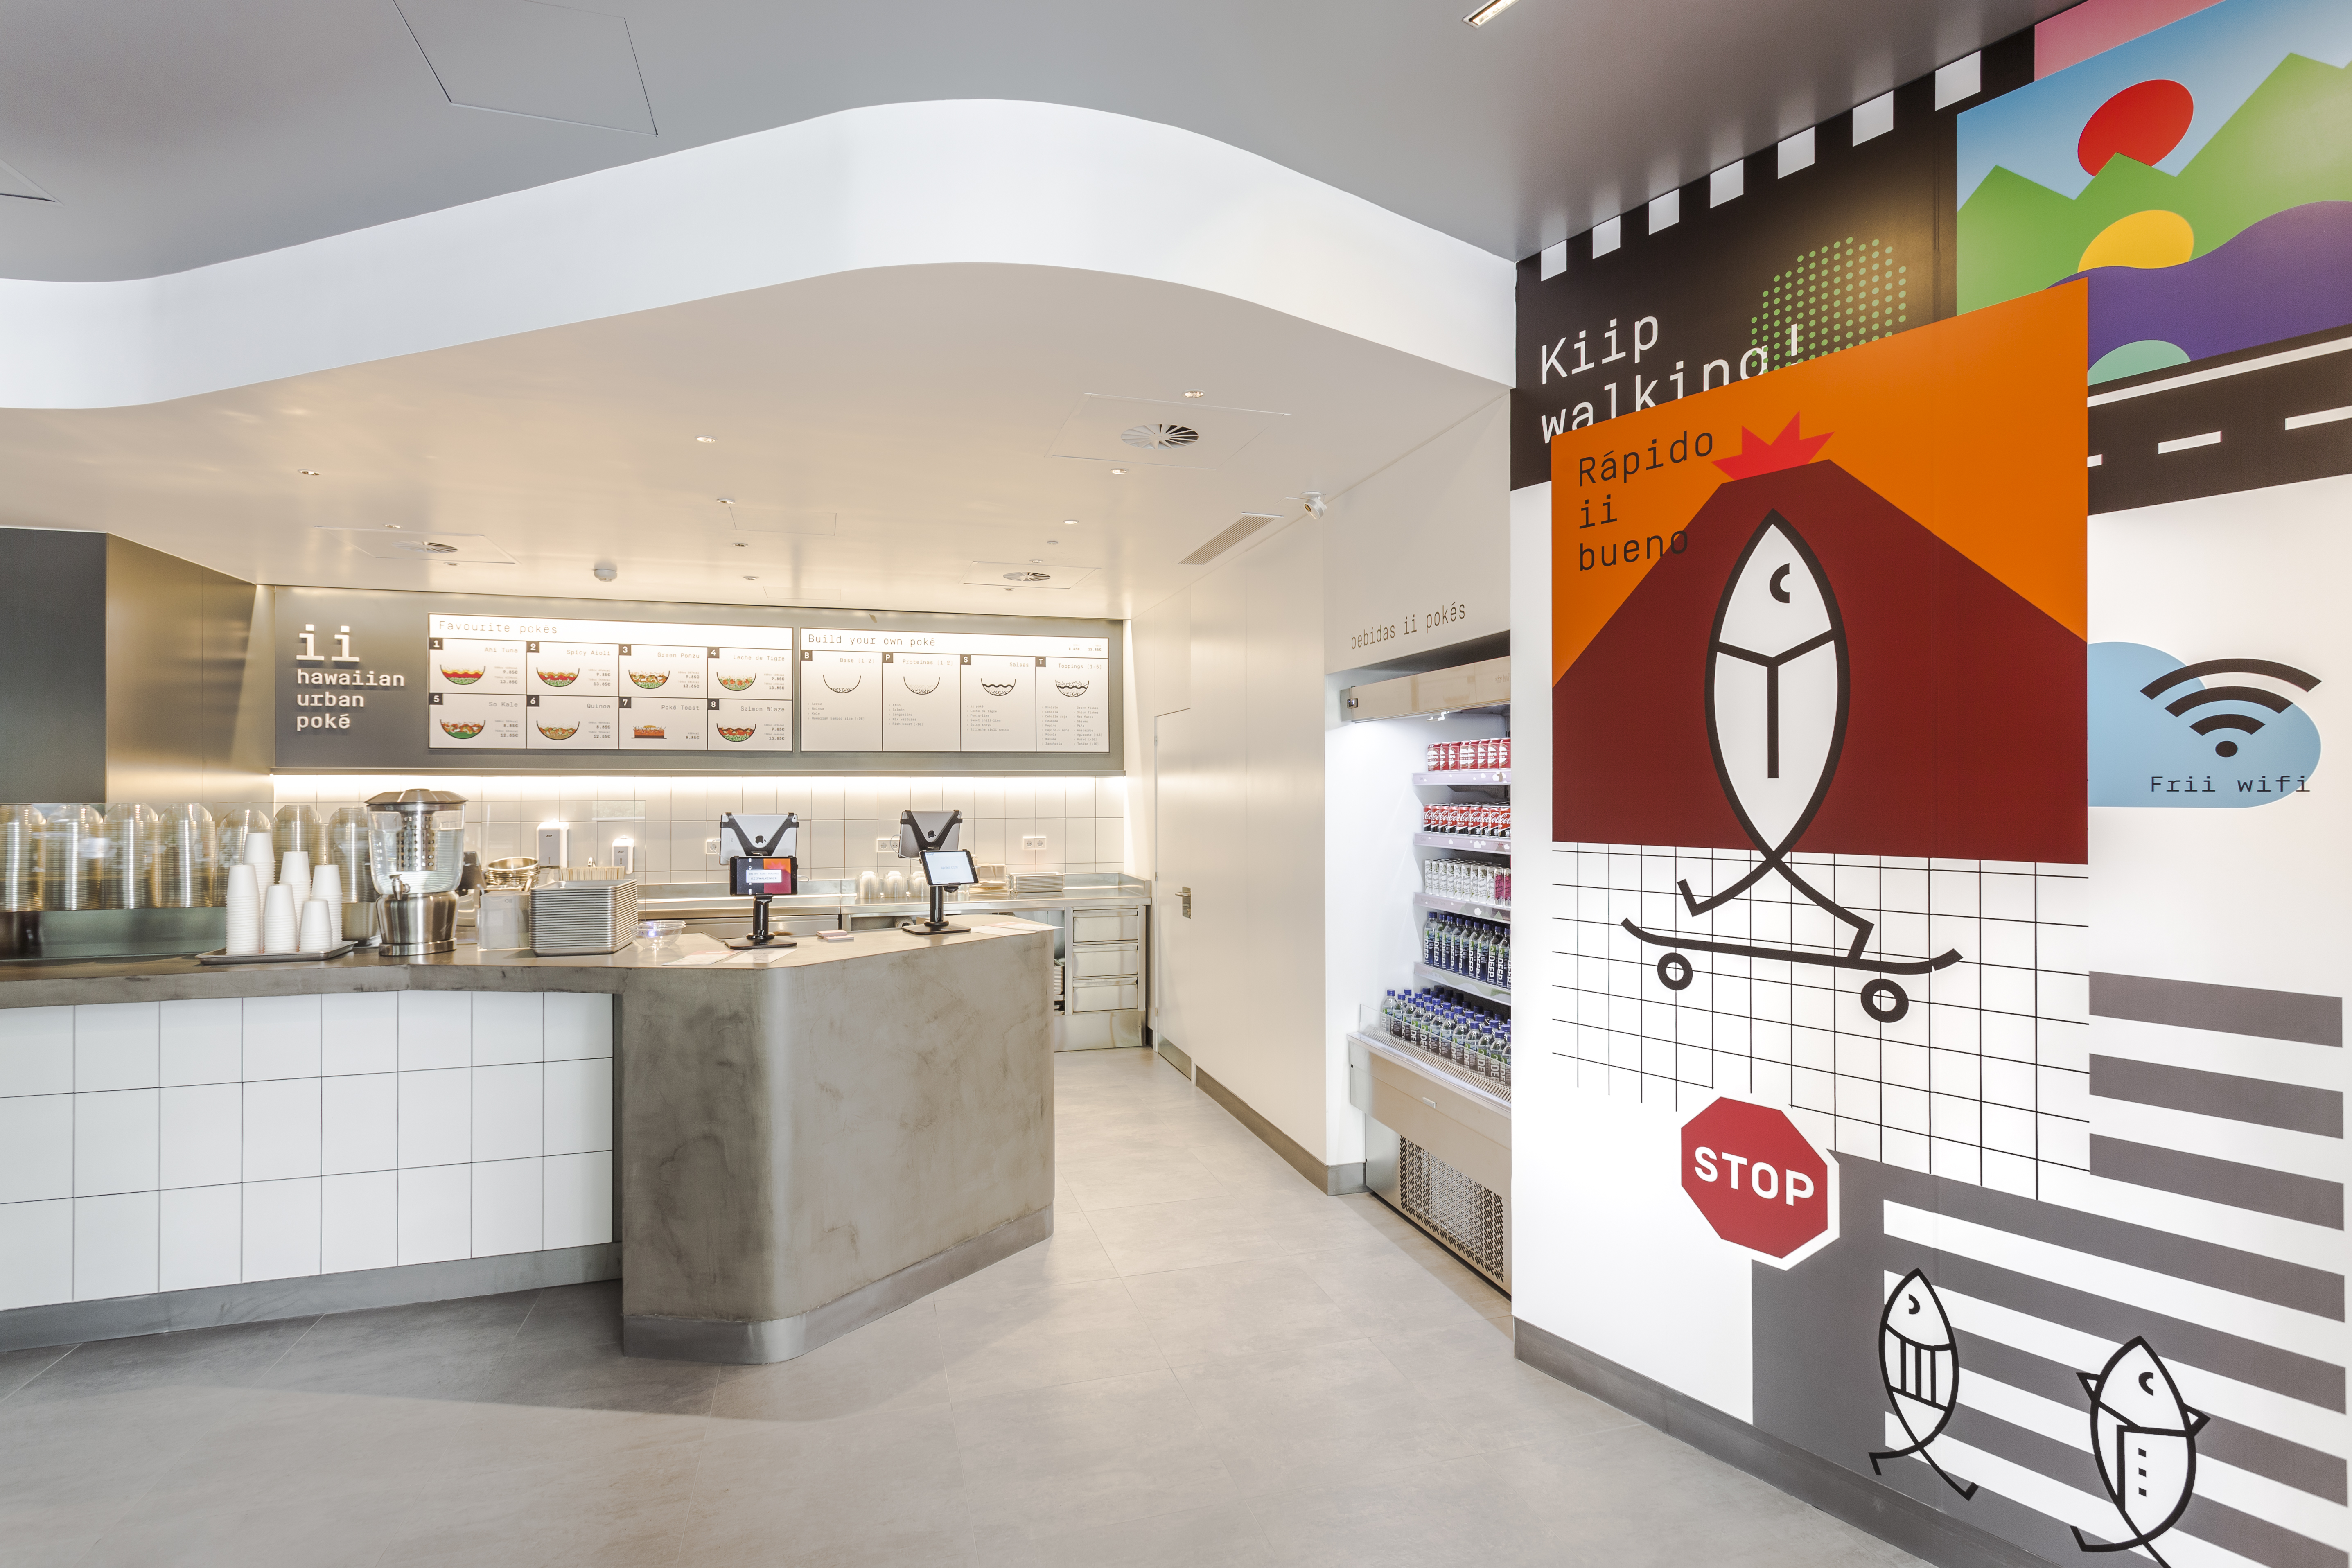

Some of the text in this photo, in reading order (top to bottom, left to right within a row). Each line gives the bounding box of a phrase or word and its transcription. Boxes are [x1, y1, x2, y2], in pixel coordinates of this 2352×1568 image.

[1542, 316, 1658, 385] Kiip
[1579, 430, 1713, 487] Rápido
[1579, 494, 1617, 529] ii
[1580, 529, 1688, 571] bueno
[296, 624, 360, 662] ii
[439, 620, 557, 634] Favourite pokés
[808, 634, 842, 643] Build
[850, 637, 876, 645] your
[910, 638, 935, 647] poké
[1351, 601, 1465, 650] bebidas ii pokés
[297, 669, 405, 686] hawaiian
[297, 691, 364, 707] urban
[297, 713, 350, 731] poké
[2151, 775, 2310, 792] Frii wifi
[1695, 1146, 1815, 1206] STOP
